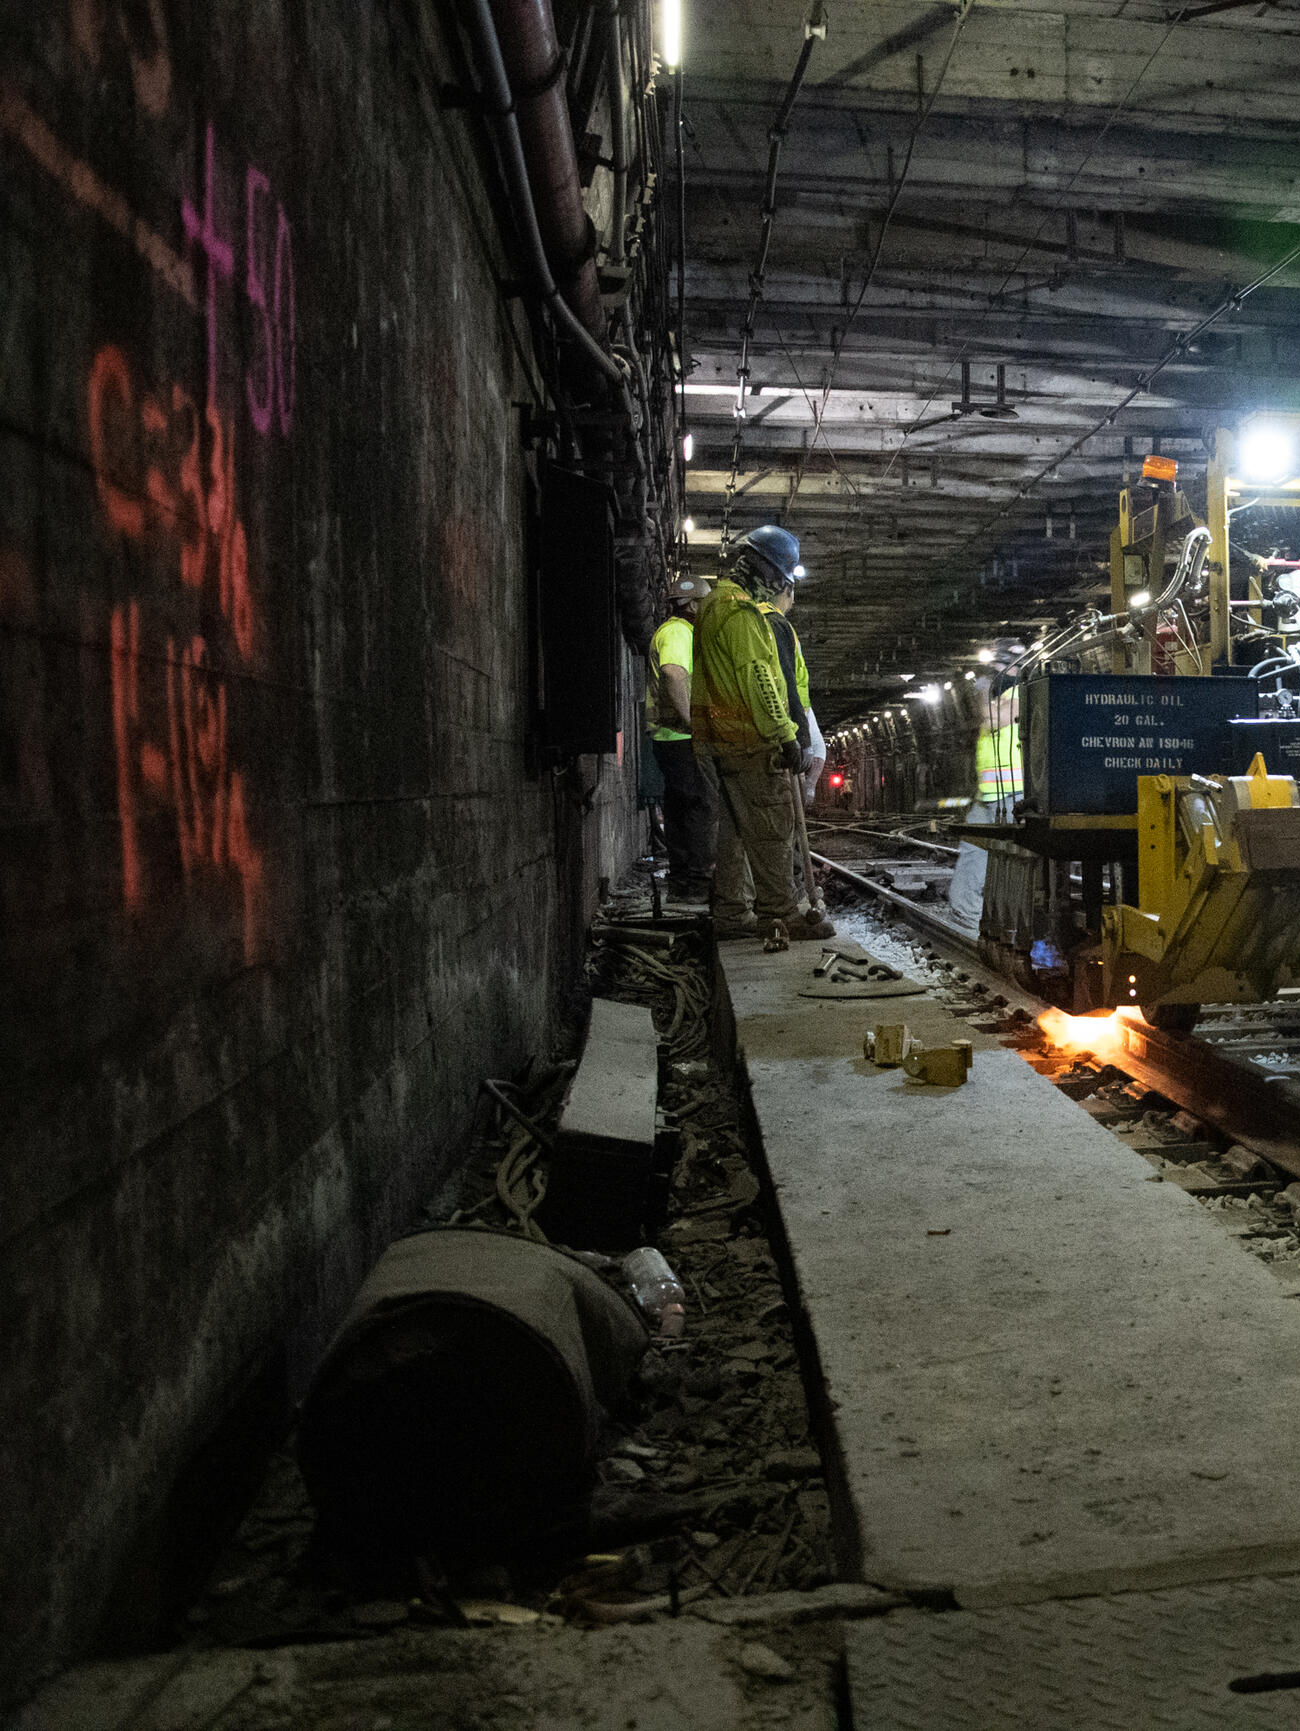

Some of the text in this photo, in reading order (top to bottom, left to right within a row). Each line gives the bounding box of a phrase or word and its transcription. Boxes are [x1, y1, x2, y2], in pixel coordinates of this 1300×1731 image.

[1085, 694, 1184, 706] HYDRAULIC OIL
[1114, 714, 1164, 726] 20 GAL.
[1081, 737, 1135, 748] CHEVRON
[1104, 757, 1183, 769] CHECK DAILY
